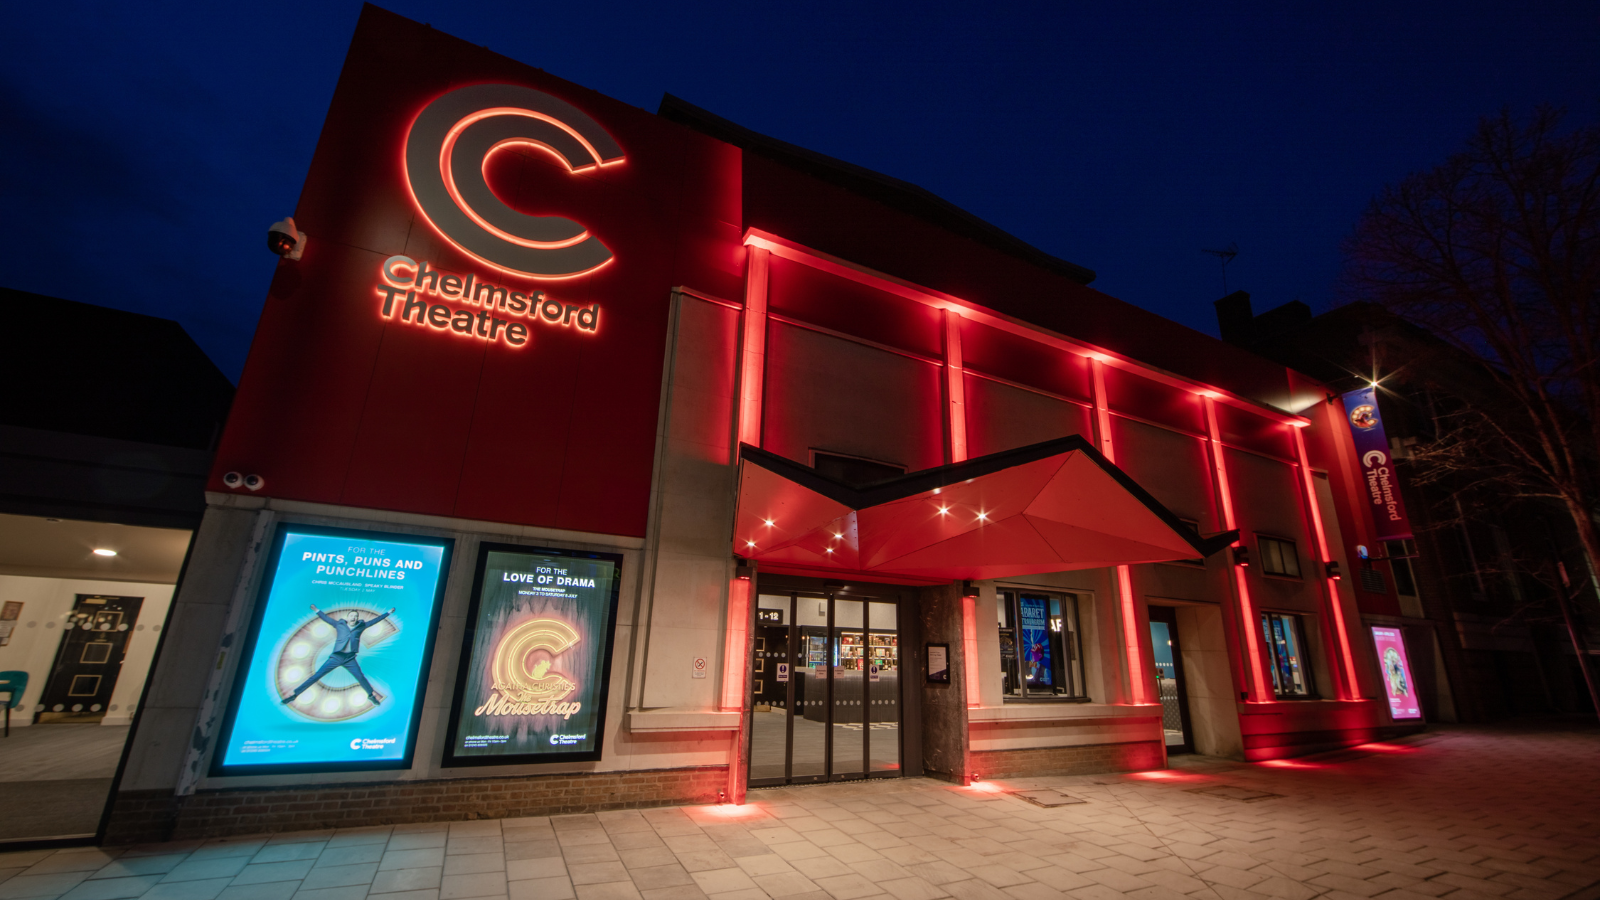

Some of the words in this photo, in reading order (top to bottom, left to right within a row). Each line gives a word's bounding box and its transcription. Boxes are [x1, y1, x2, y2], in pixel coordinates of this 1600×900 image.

[382, 254, 600, 333] Chelmsford
[376, 284, 528, 347] Theatre
[1366, 468, 1383, 505] Theatre
[1377, 467, 1402, 521] Chelmsford
[347, 546, 366, 554] FOR
[370, 547, 386, 556] THE
[302, 551, 349, 566] PINTS,
[354, 556, 391, 568] PUNS
[395, 559, 423, 570] AND
[316, 564, 406, 580] PUNCHLINES
[536, 566, 551, 574] FOR
[553, 567, 568, 576] THE
[503, 572, 534, 583] LOVE
[537, 574, 554, 585] OF
[556, 576, 596, 588] DRAMA
[1021, 606, 1045, 619] ABARET
[491, 682, 528, 690] AGATHA
[517, 691, 532, 702] The
[474, 693, 582, 720] Mousetrap
